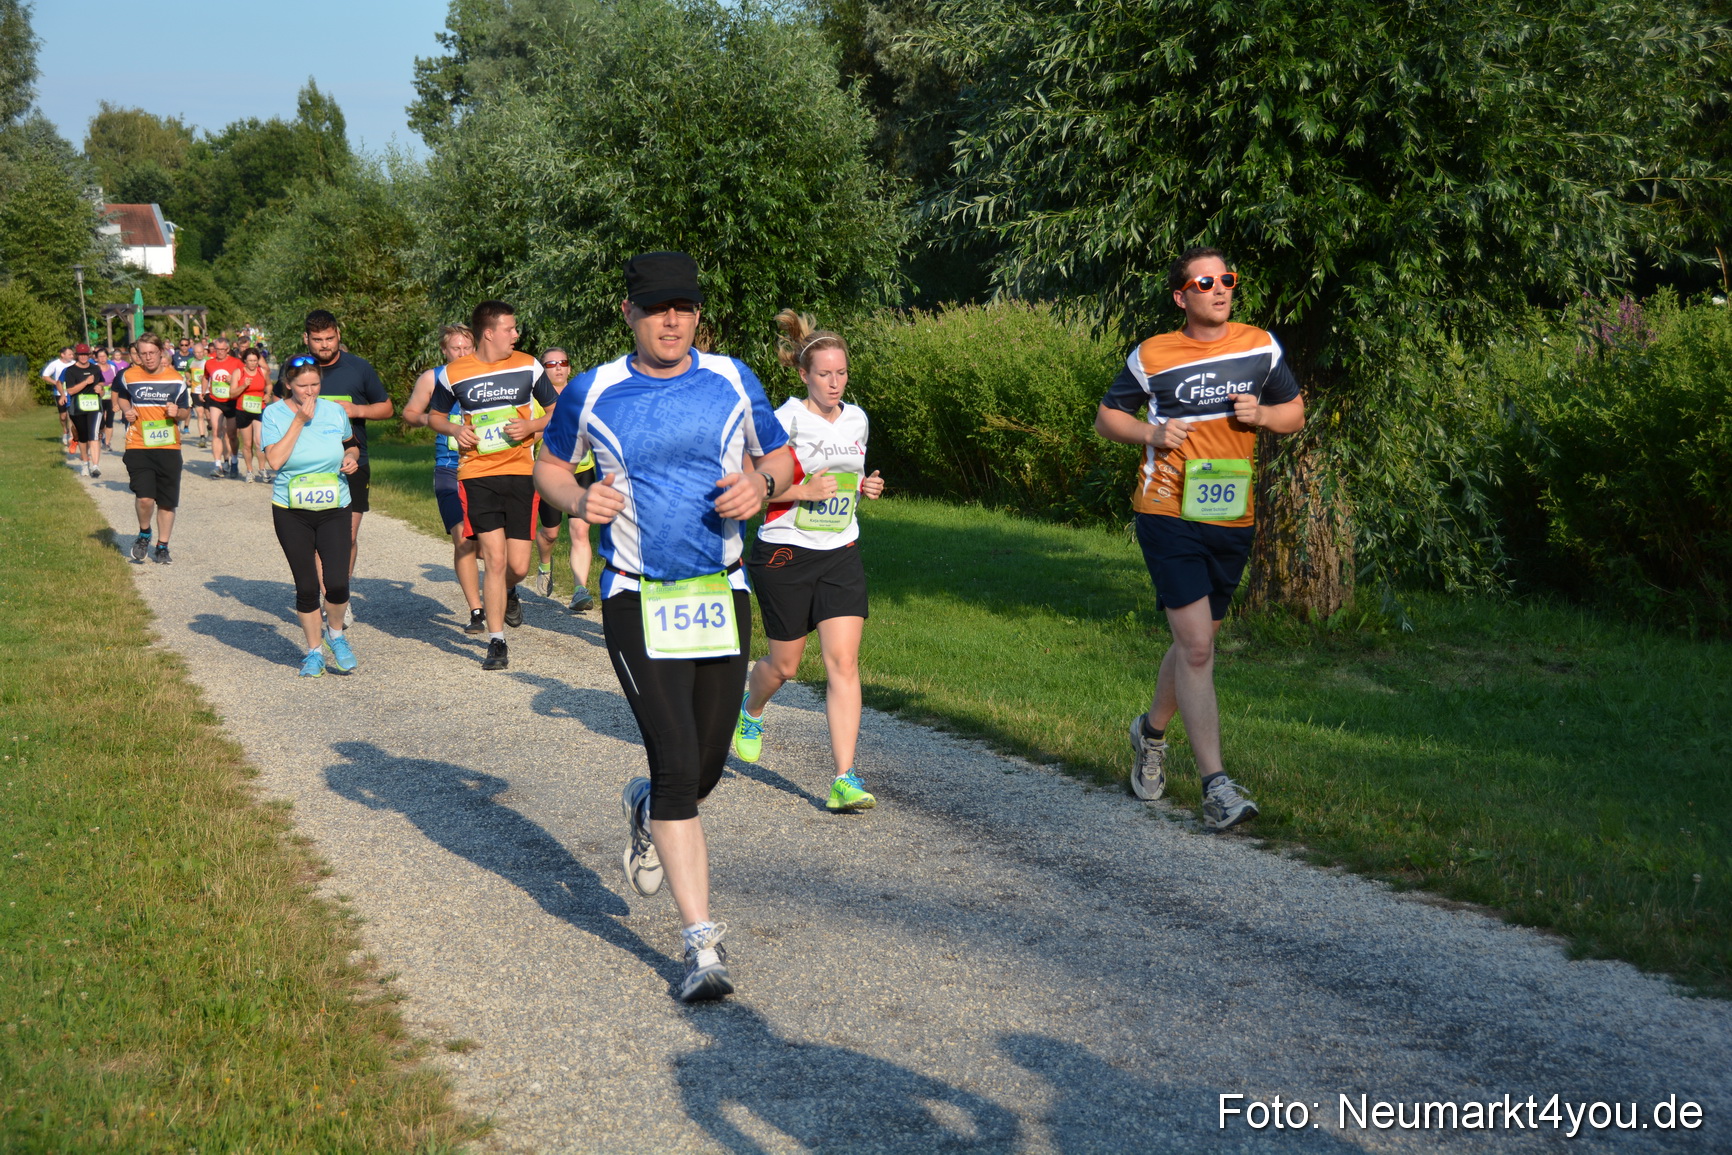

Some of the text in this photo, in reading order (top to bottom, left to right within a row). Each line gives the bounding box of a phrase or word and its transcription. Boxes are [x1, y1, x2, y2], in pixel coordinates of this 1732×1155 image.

[140, 390, 171, 398] Fischer
[477, 386, 520, 400] Fischer
[1190, 381, 1253, 399] Fischer
[482, 395, 517, 403] AUTOMOBILE
[149, 430, 169, 440] 446
[651, 416, 711, 551] Was treibt Dich an?
[295, 490, 335, 504] 1429
[1196, 483, 1236, 503] 396
[654, 602, 726, 631] 1543
